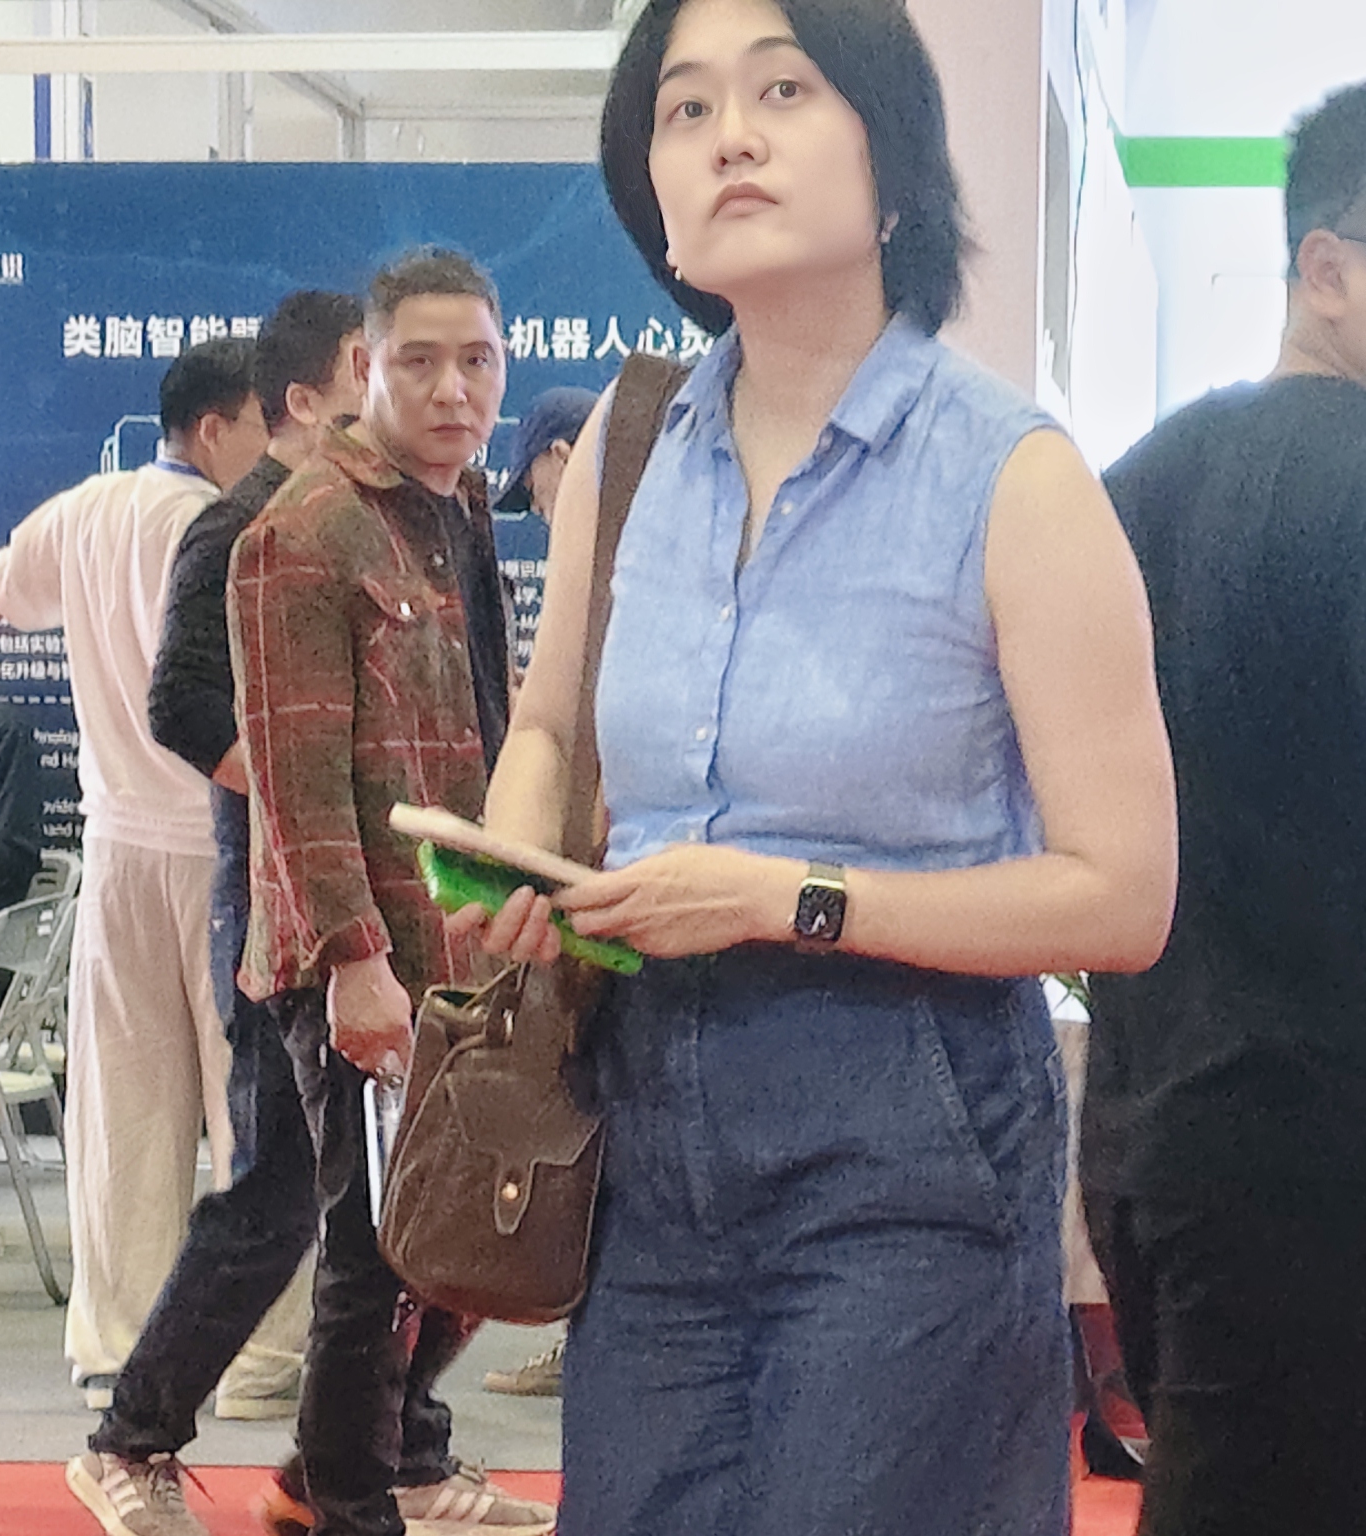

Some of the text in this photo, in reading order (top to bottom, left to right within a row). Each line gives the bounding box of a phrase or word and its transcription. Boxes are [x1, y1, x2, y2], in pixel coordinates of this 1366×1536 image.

[509, 315, 714, 360] 机器人心灵
